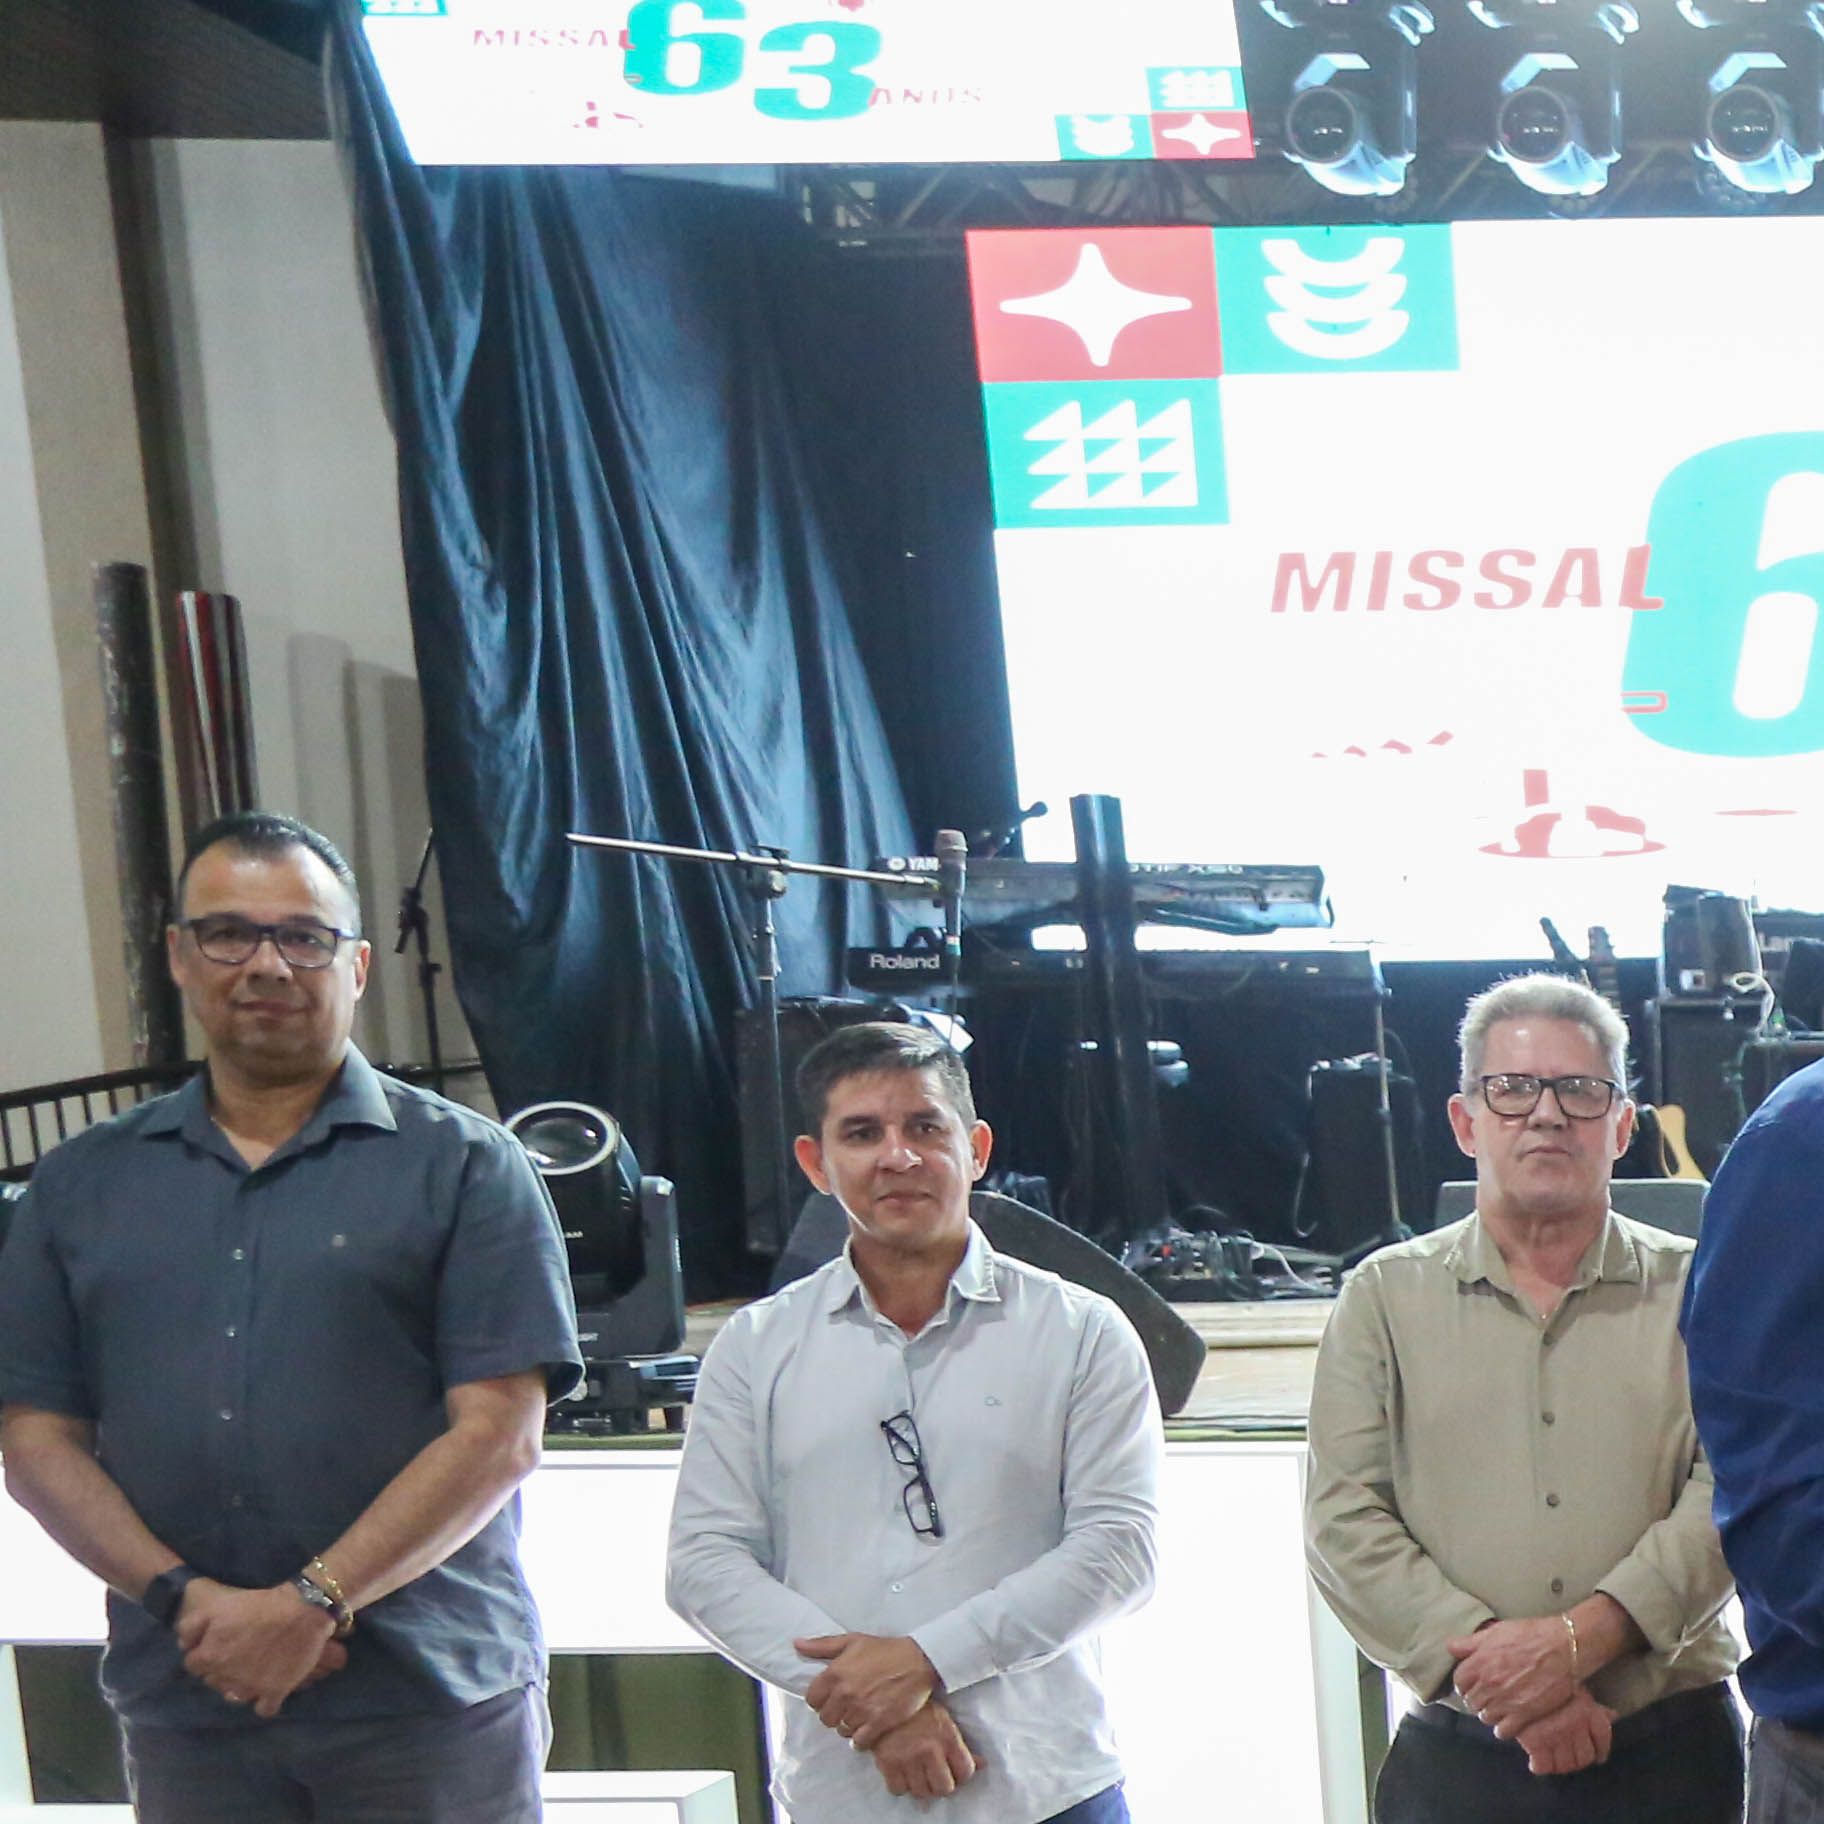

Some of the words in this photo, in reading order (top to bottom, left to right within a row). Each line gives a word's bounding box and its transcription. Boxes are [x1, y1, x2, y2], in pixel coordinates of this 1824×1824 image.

[622, 0, 884, 121] 63
[1270, 545, 1666, 613] MISSAL
[869, 953, 940, 970] Roland
